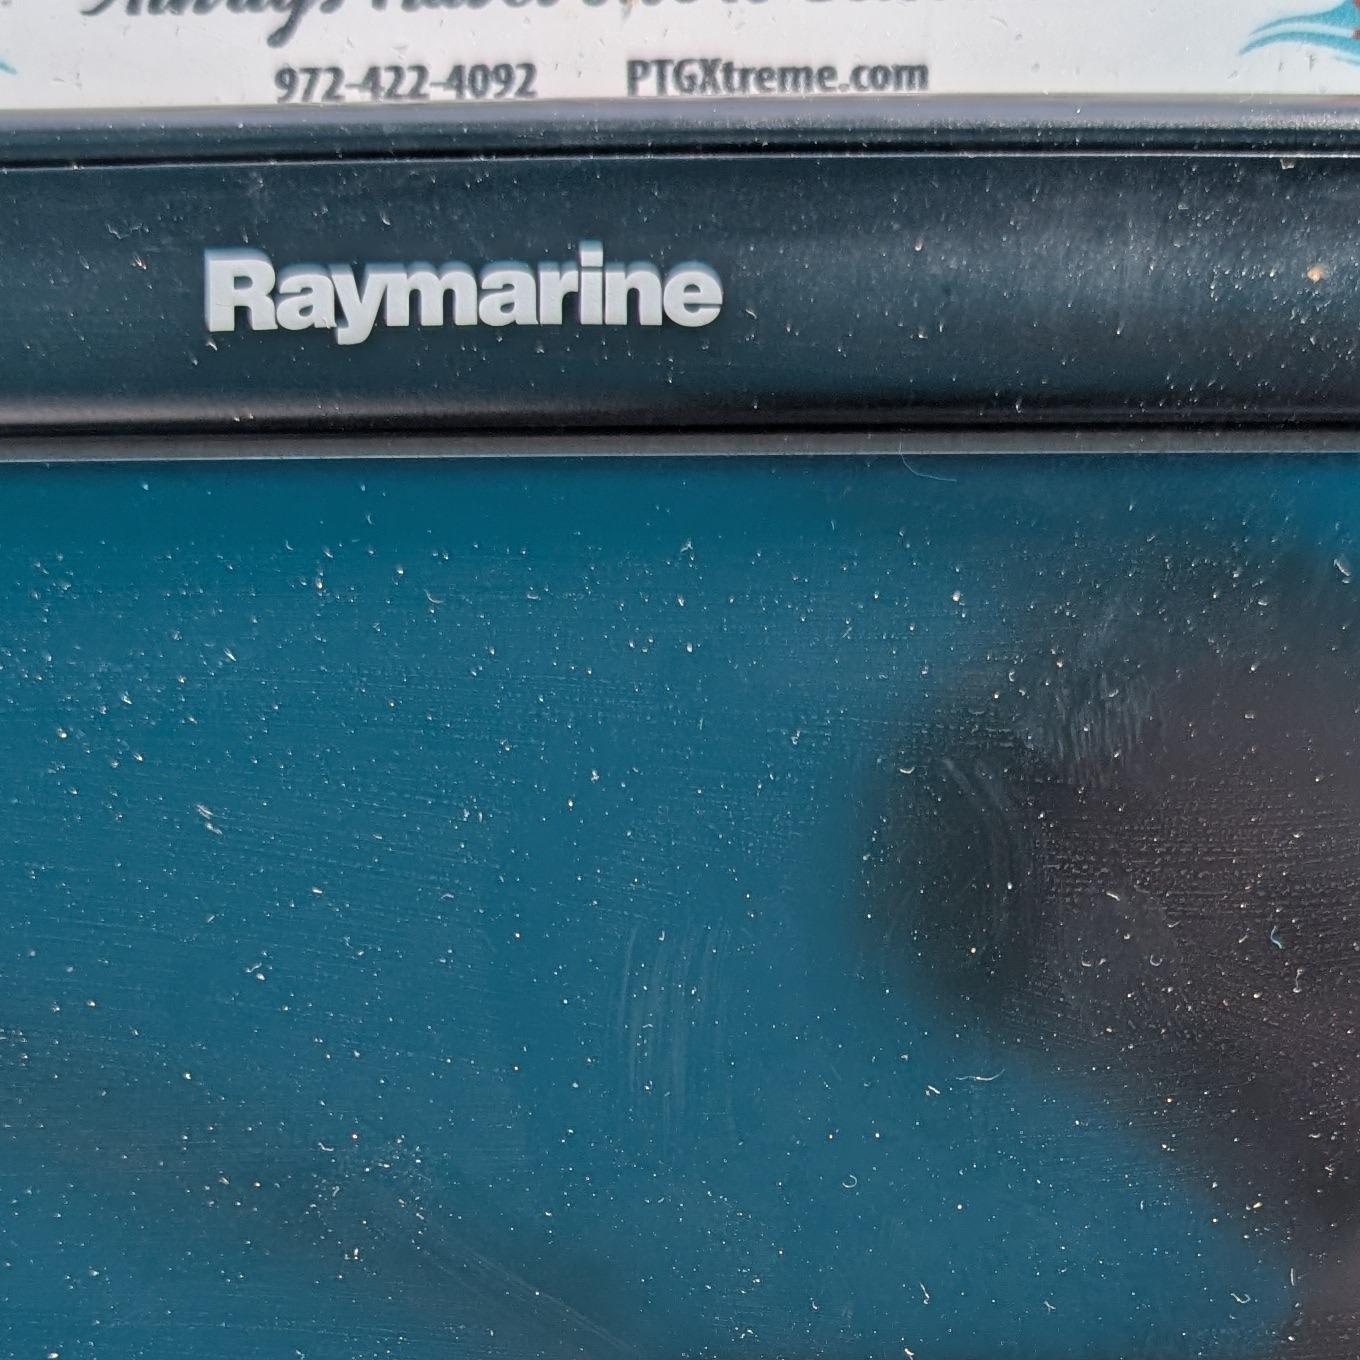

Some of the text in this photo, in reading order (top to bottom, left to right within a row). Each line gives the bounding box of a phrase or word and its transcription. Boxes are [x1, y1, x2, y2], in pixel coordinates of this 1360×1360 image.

[275, 64, 537, 102] 972-422-4092
[626, 58, 929, 96] PTGXtreme.com
[204, 239, 723, 345] Raymarine
